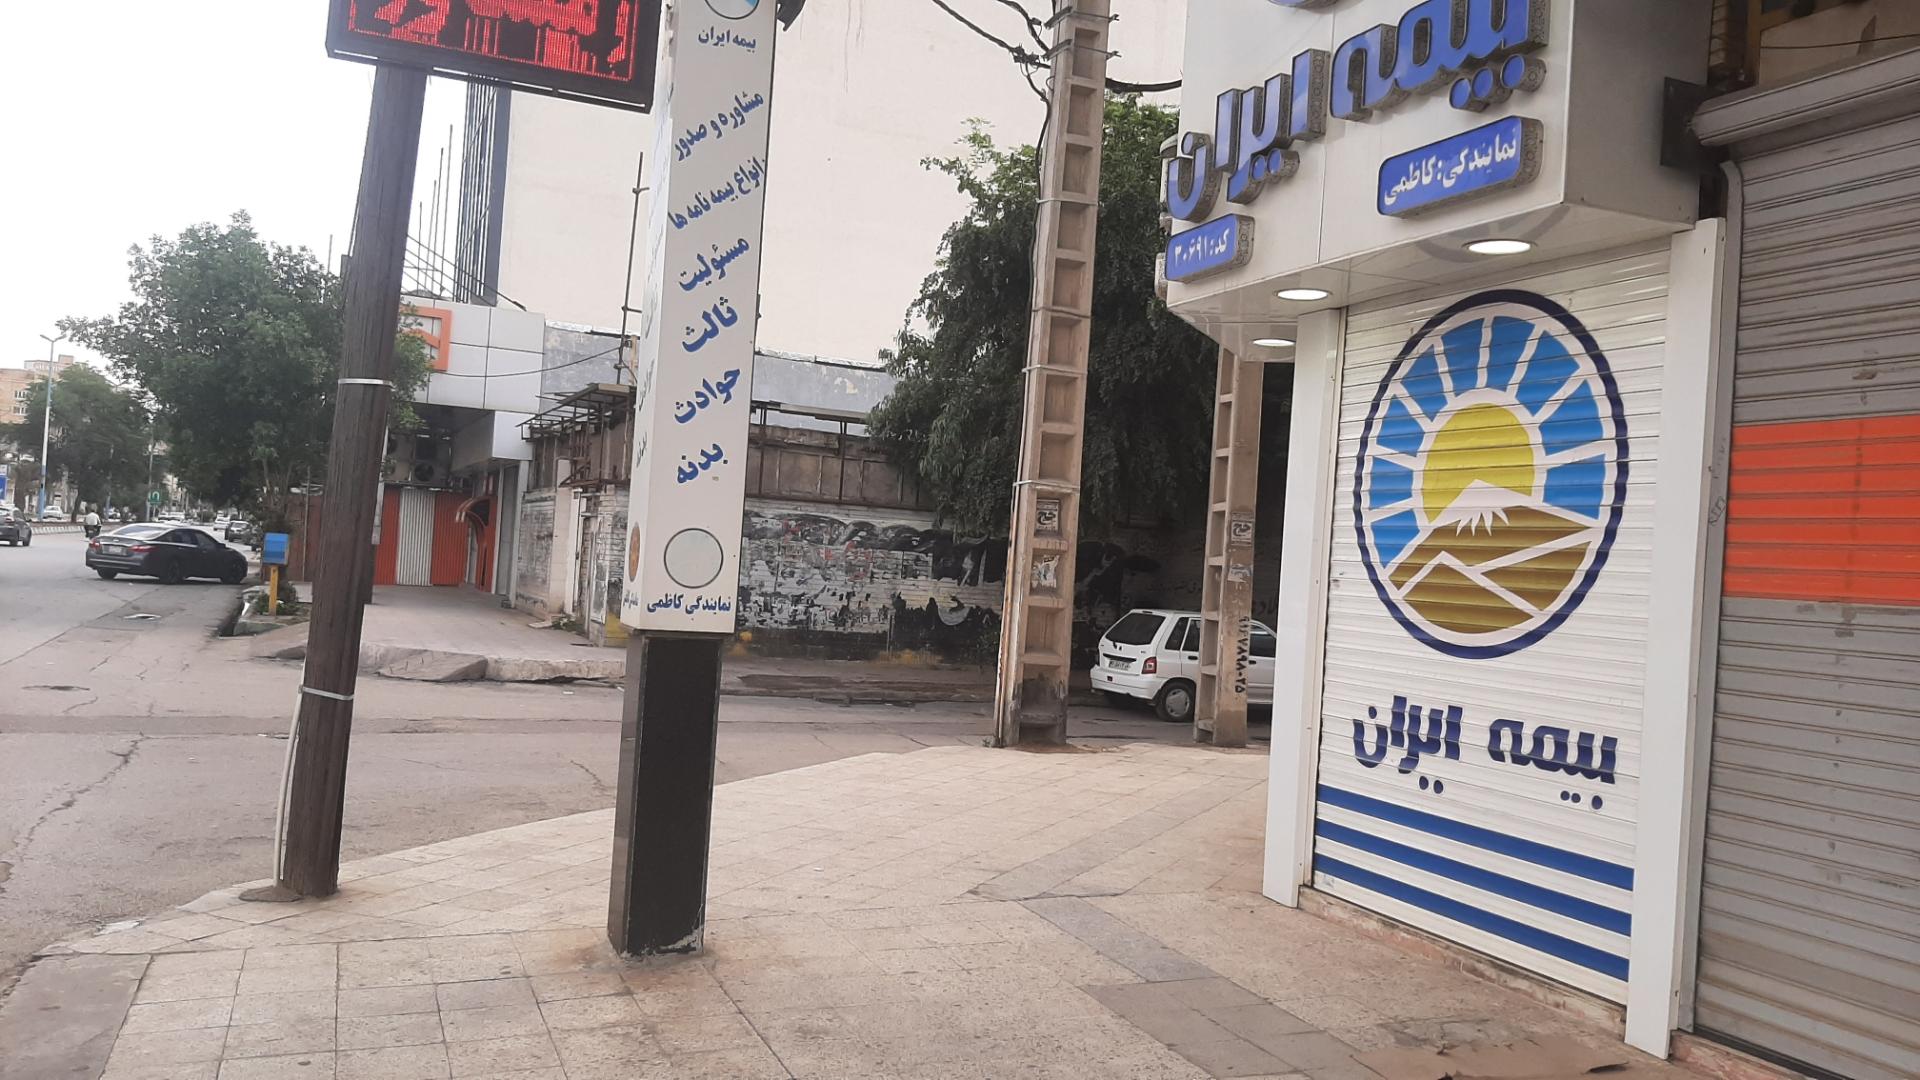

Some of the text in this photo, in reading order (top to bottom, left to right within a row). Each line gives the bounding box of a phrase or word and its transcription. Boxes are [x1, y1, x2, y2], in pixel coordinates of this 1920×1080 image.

[698, 26, 757, 53] بیمه ایران
[674, 91, 764, 161] مشاوره و صدور
[1167, 0, 1545, 222] بیمه ایران
[667, 156, 765, 230] انواع بیمه نامه ها
[679, 237, 750, 291] مسئولیت
[682, 296, 739, 352] ثالث
[674, 368, 741, 424] حوادث
[676, 443, 729, 484] بدنه
[647, 592, 684, 613] کاظمی
[685, 595, 731, 615] نمایندگی
[1352, 695, 1618, 810] بیمه ایران
